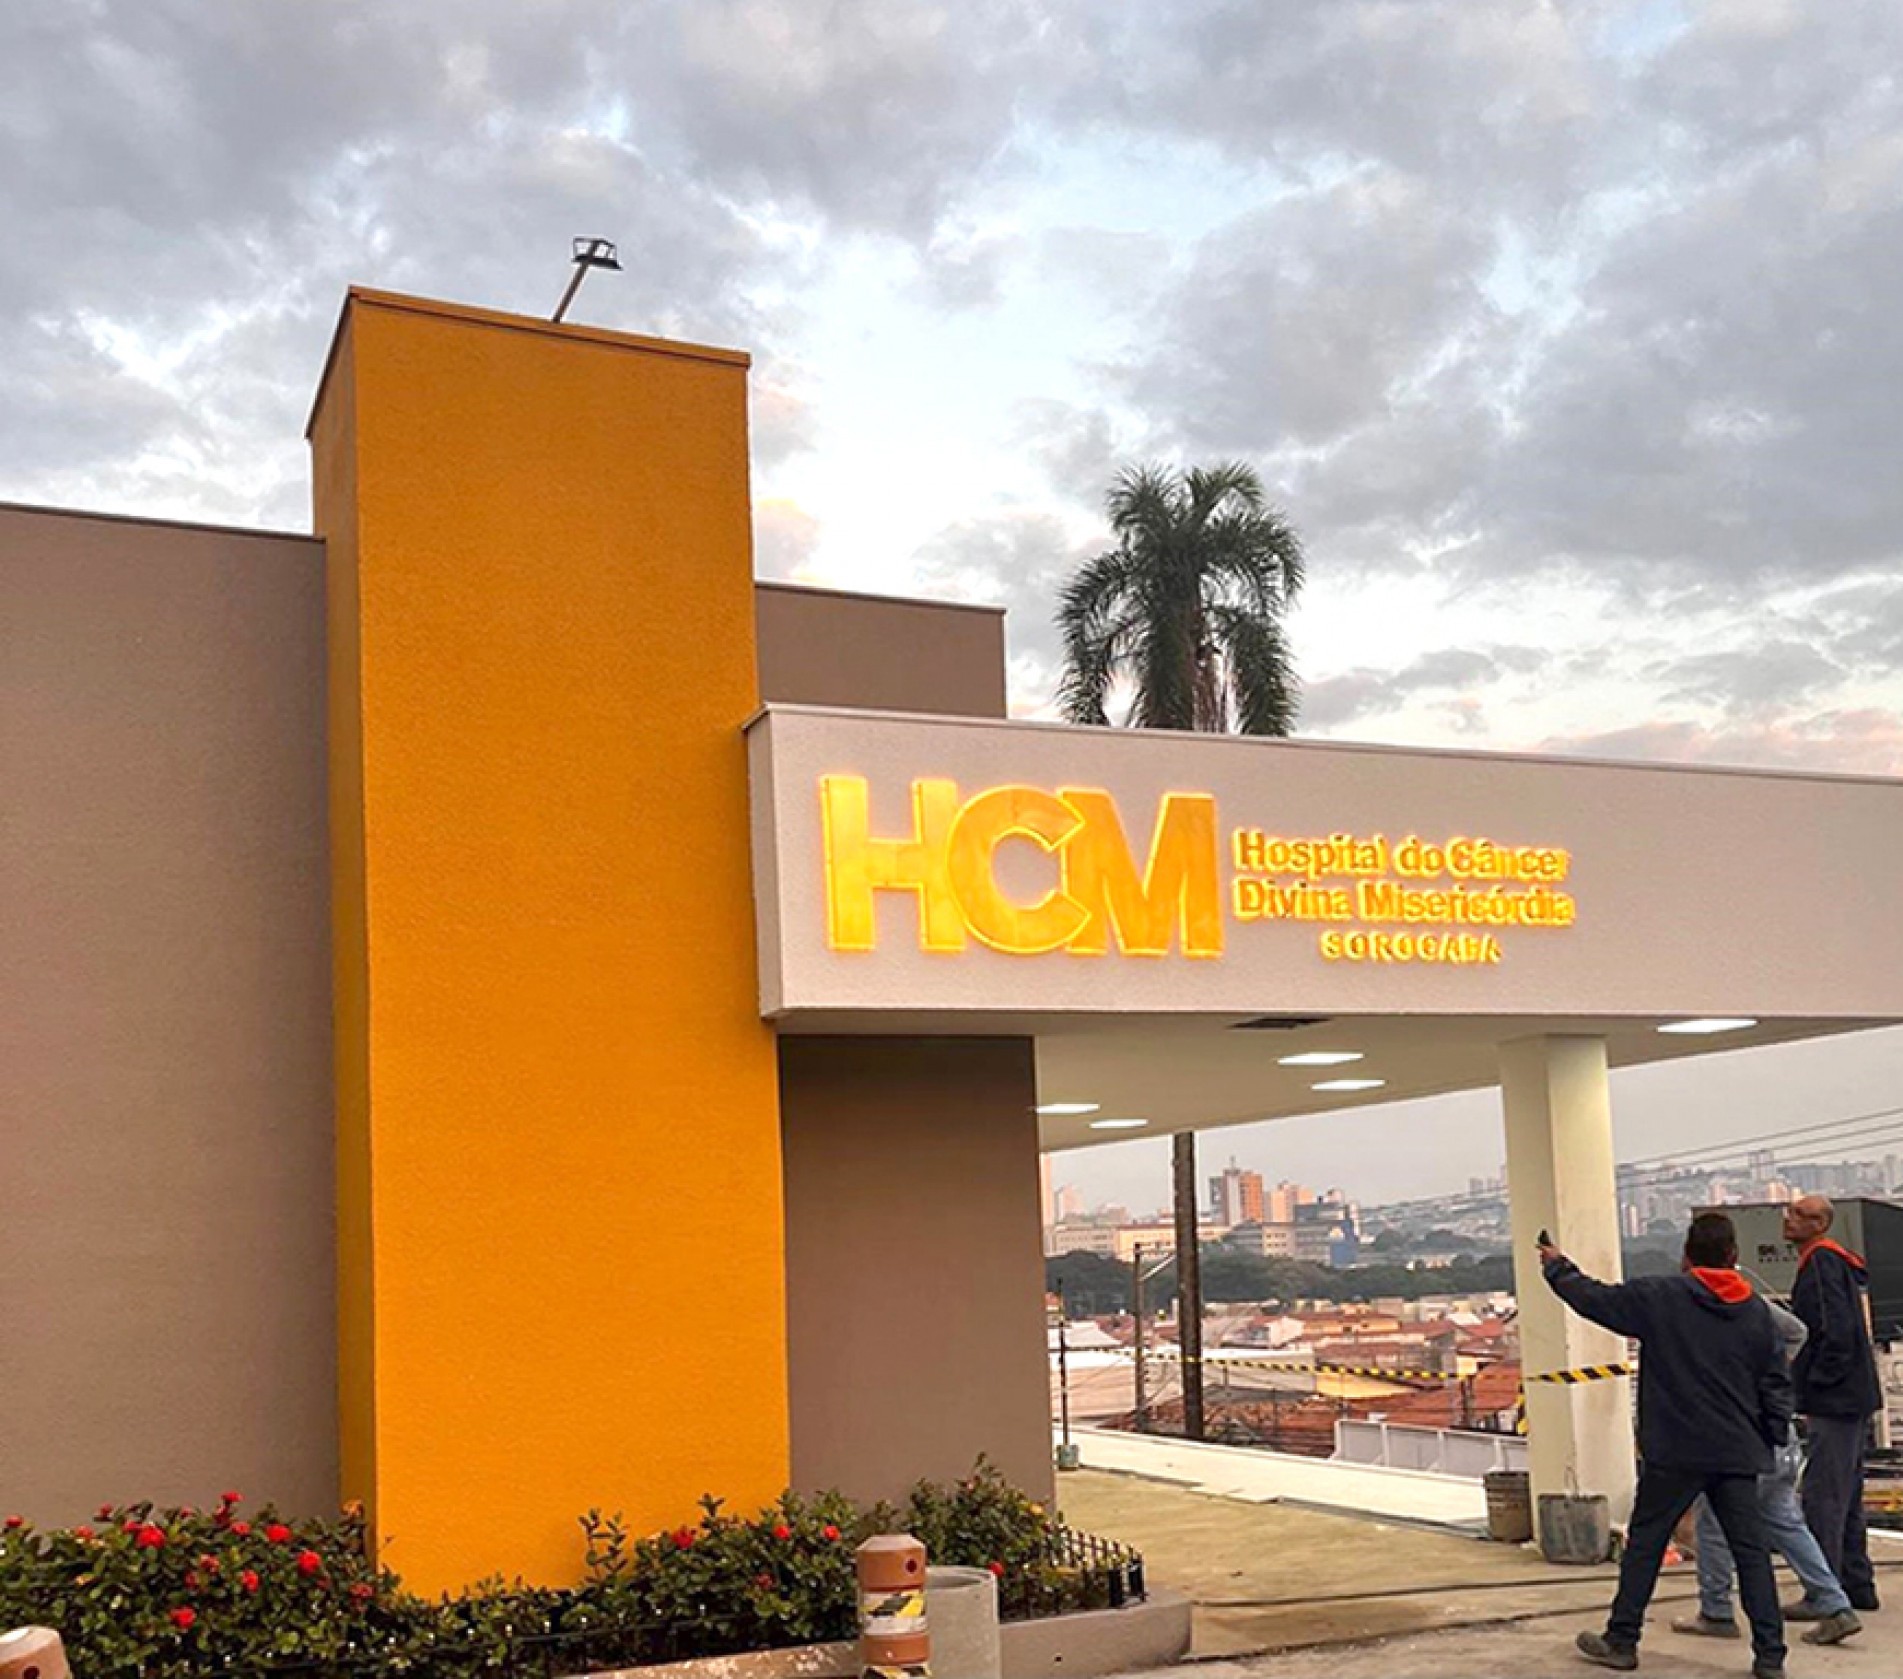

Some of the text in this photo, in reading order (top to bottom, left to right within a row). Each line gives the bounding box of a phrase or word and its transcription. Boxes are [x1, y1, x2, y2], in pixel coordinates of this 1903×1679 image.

[820, 774, 1224, 957] HCM
[1233, 828, 1387, 878] Hospital
[1445, 837, 1571, 881] Câncer
[1233, 877, 1575, 926] Divina Misericórdia
